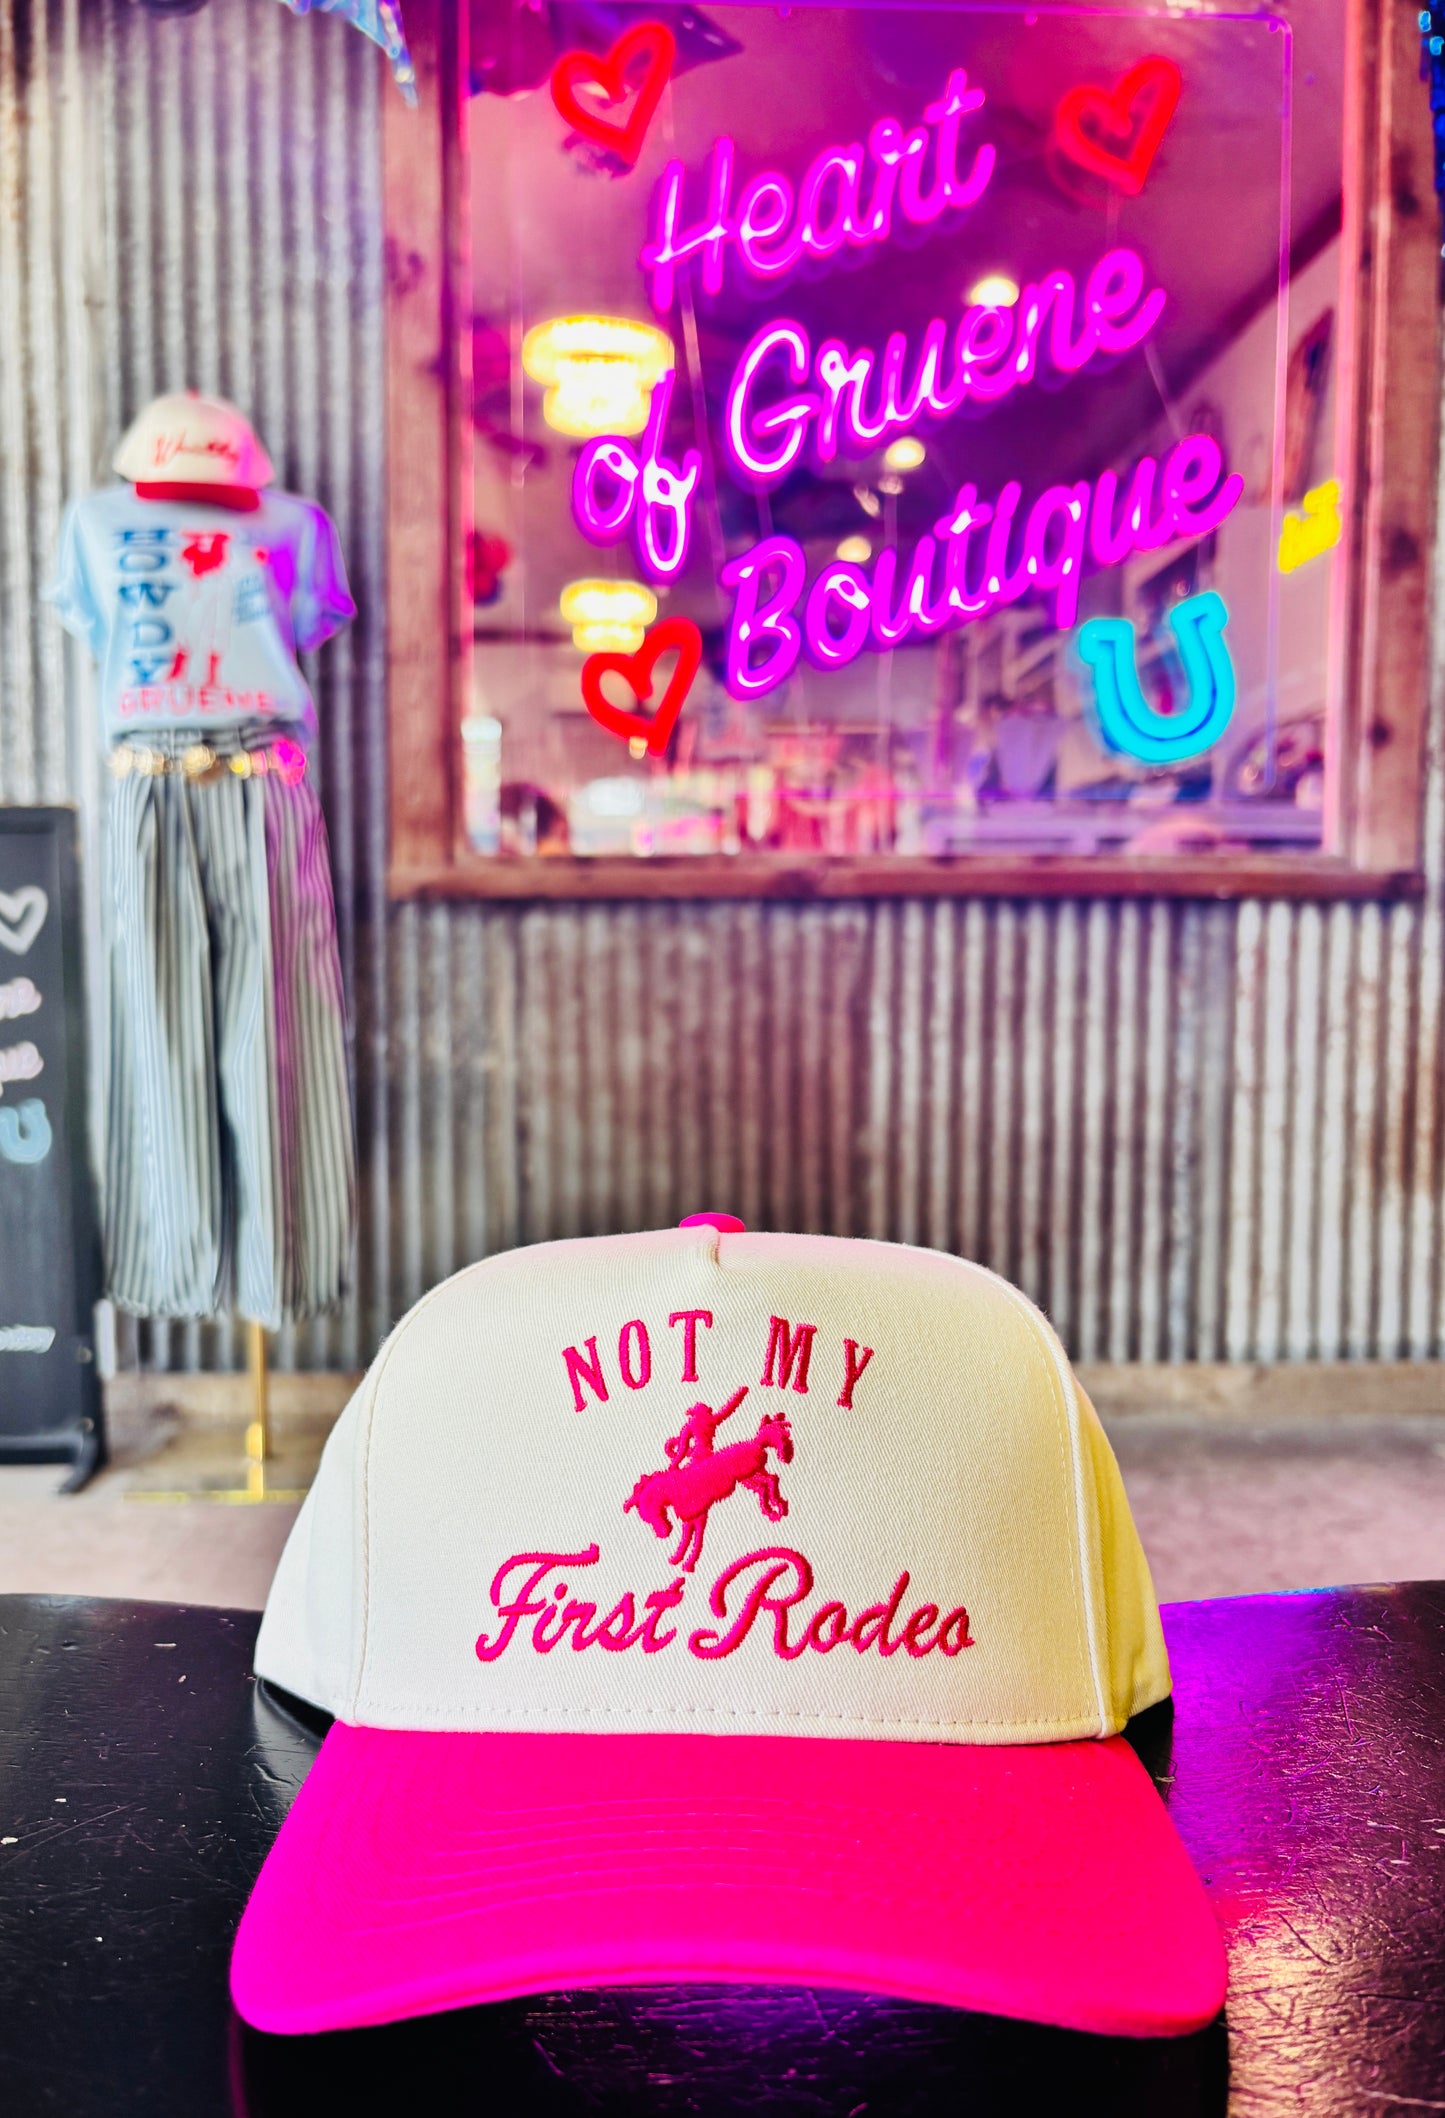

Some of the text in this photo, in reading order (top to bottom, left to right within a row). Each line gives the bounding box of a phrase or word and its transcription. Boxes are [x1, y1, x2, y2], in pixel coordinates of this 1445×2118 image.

[643, 68, 997, 311] Heart
[573, 248, 1167, 580] of Gruene
[722, 434, 1245, 700] Boutique
[562, 1309, 874, 1412] NOT MY
[475, 1543, 975, 1661] First Rodeo
